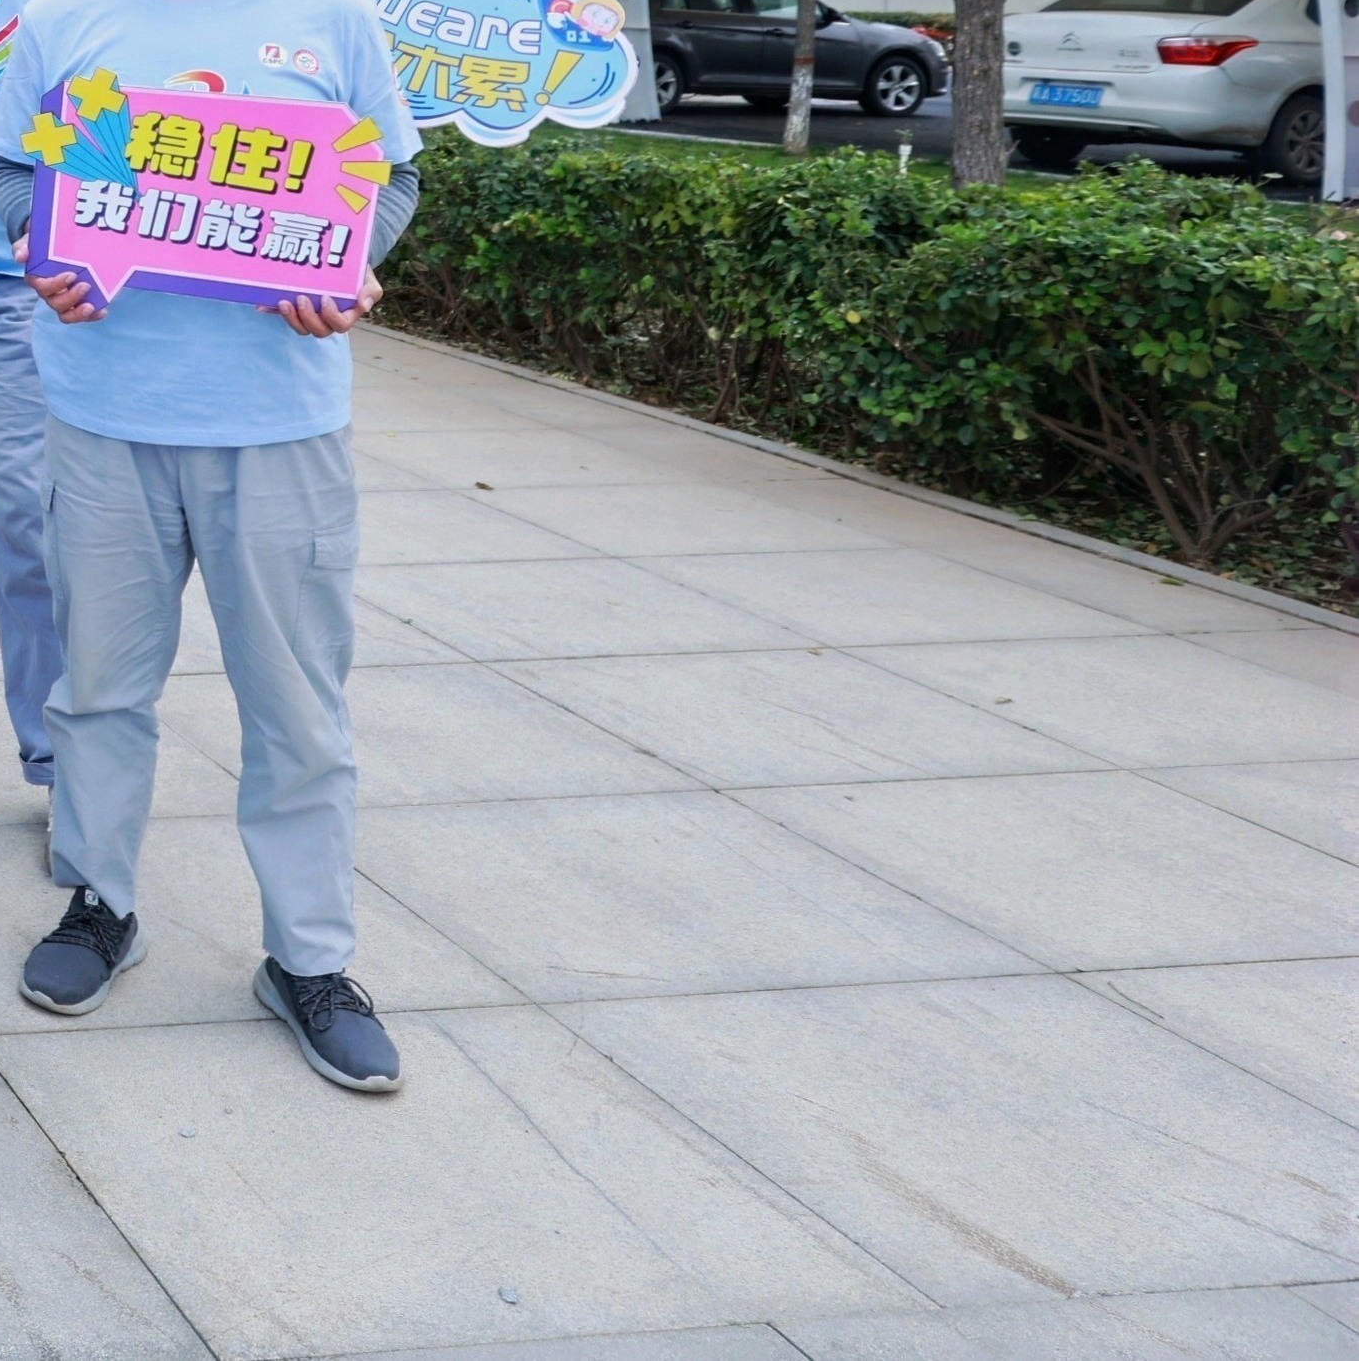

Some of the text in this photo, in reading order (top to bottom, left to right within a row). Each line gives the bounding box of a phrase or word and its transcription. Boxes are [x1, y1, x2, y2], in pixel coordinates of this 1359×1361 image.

[263, 57, 284, 65] CSPC
[384, 29, 583, 112] 木累!
[566, 30, 591, 43] 01
[125, 111, 313, 193] 稳住!
[74, 179, 351, 267] 我们能赢!
